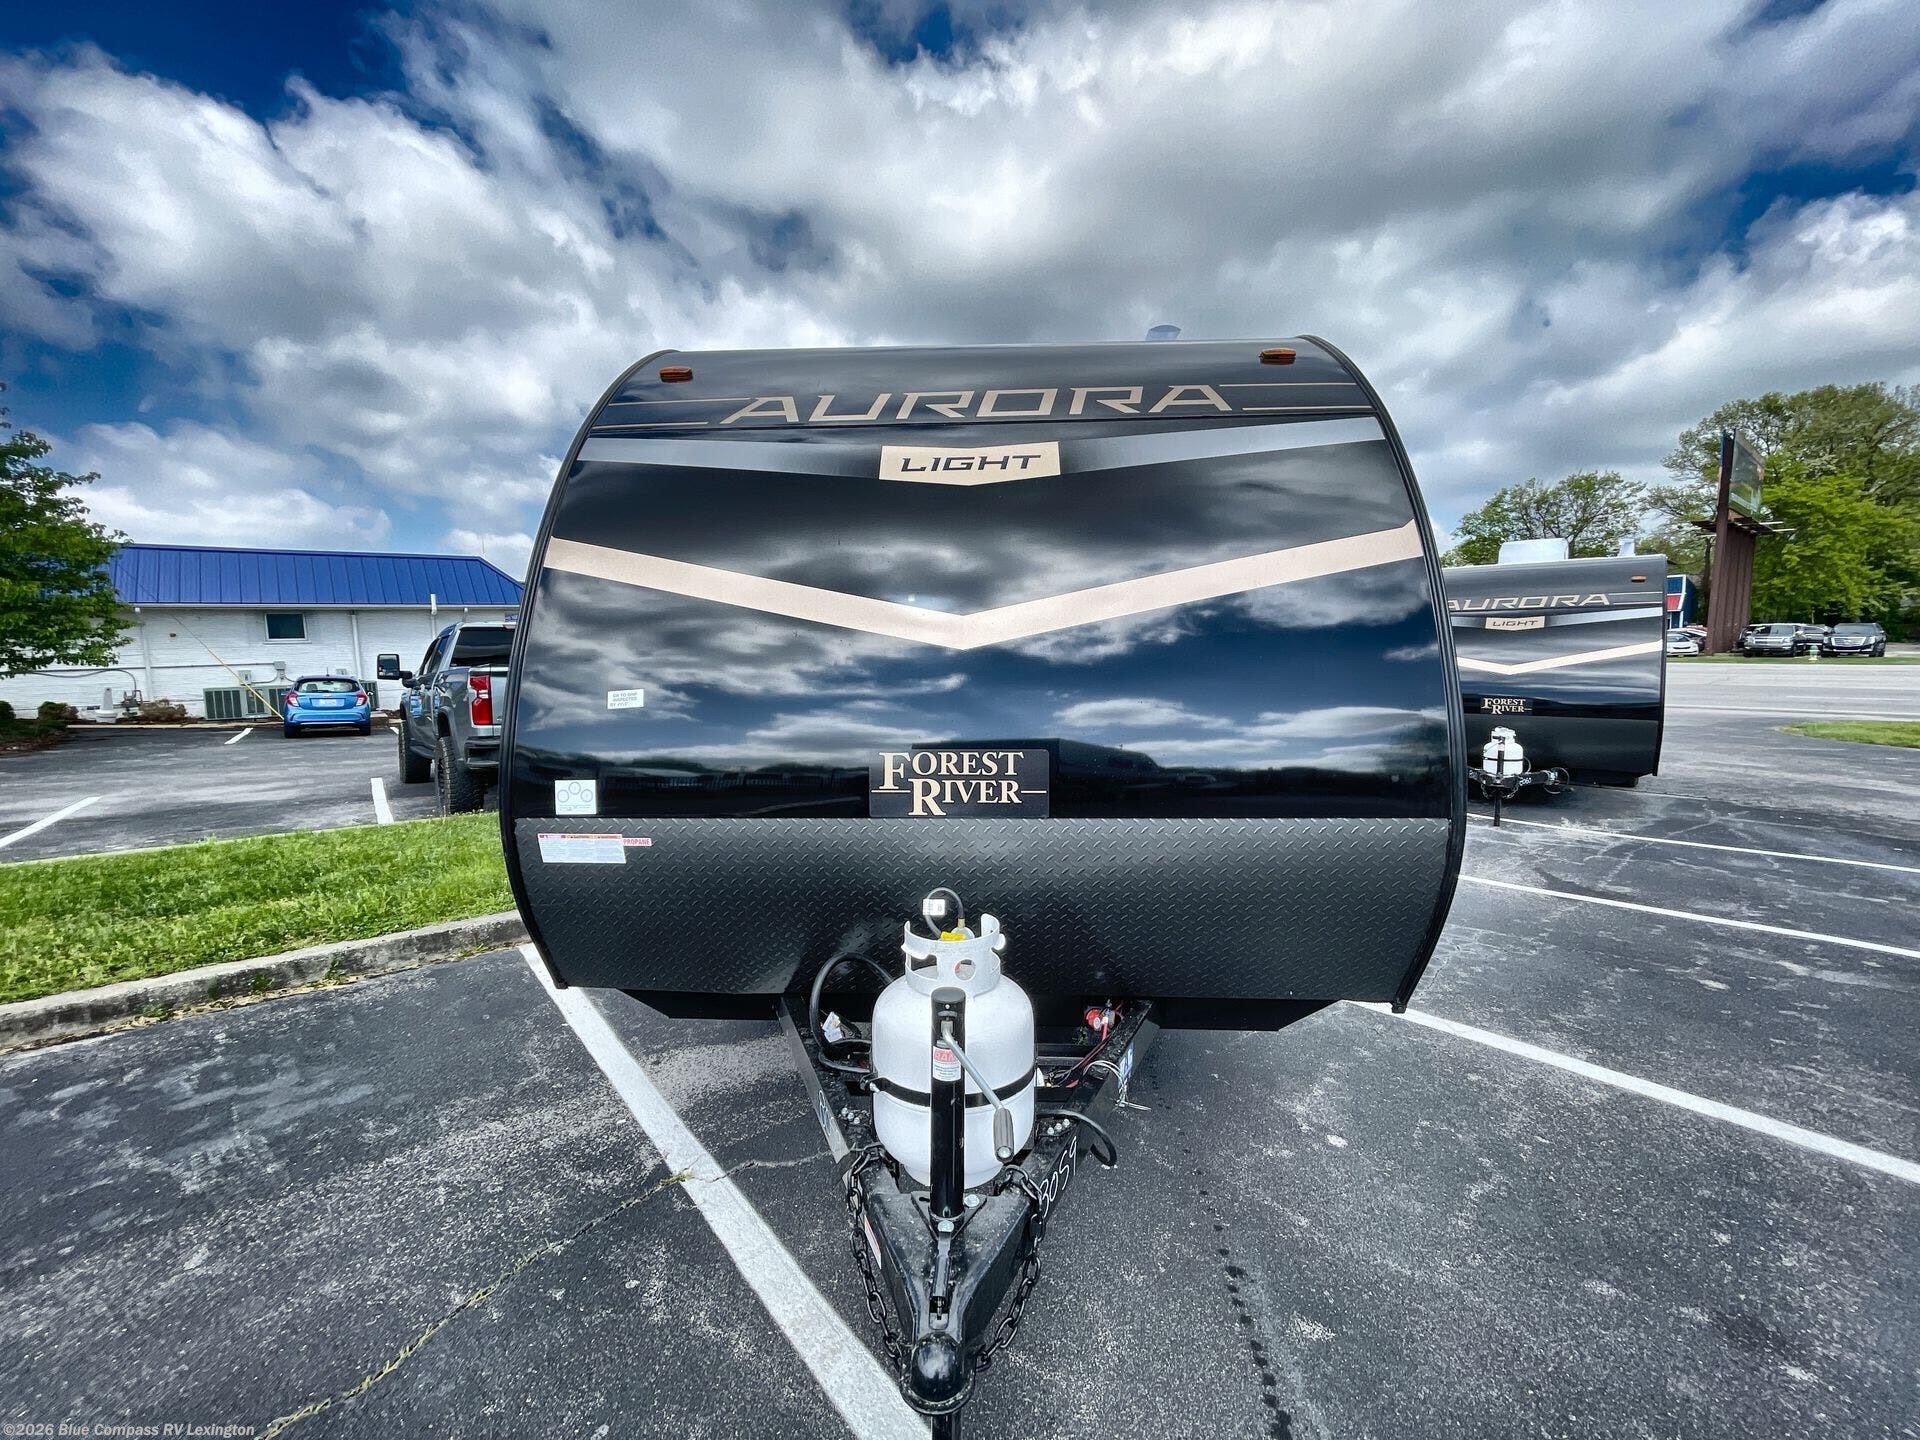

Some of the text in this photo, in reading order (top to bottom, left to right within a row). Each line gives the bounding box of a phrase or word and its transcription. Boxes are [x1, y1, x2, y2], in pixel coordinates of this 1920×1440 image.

[722, 384, 1233, 424] AURORA
[900, 453, 1042, 474] LIGHT
[1483, 697, 1526, 709] FOREST
[1491, 704, 1525, 715] RIVER
[878, 751, 1025, 790] FOREST
[907, 778, 1023, 816] RIVER
[623, 838, 650, 846] PROPANE
